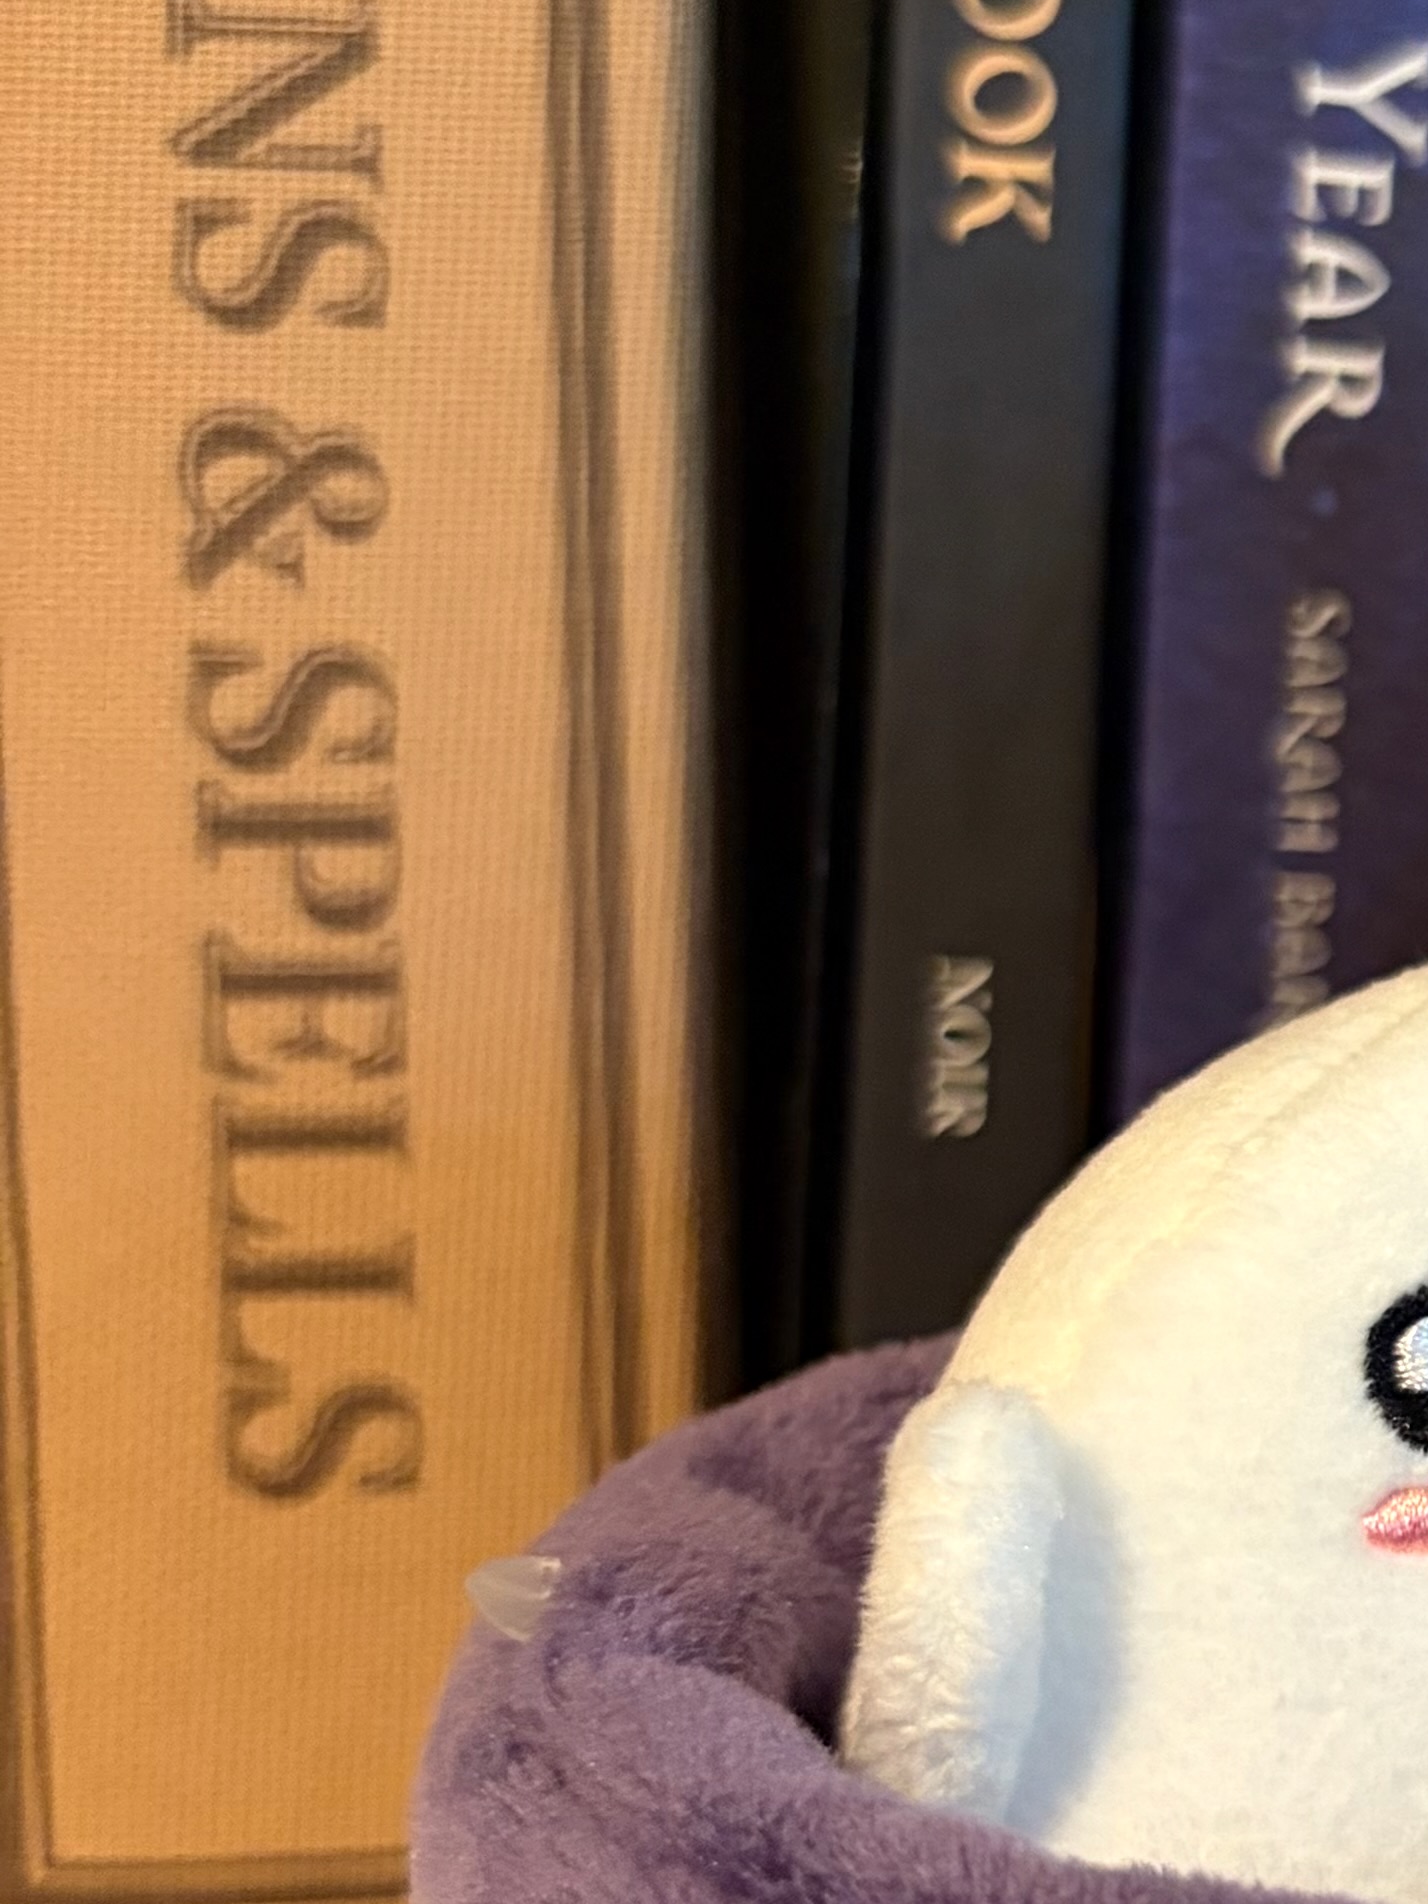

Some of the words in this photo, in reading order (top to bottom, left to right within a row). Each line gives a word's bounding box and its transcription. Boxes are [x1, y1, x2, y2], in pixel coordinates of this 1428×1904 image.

[178, 404, 390, 586] &
[1273, 589, 1353, 853] SARAH
[188, 642, 422, 1504] SPELLS
[925, 954, 995, 1139] NOIR
